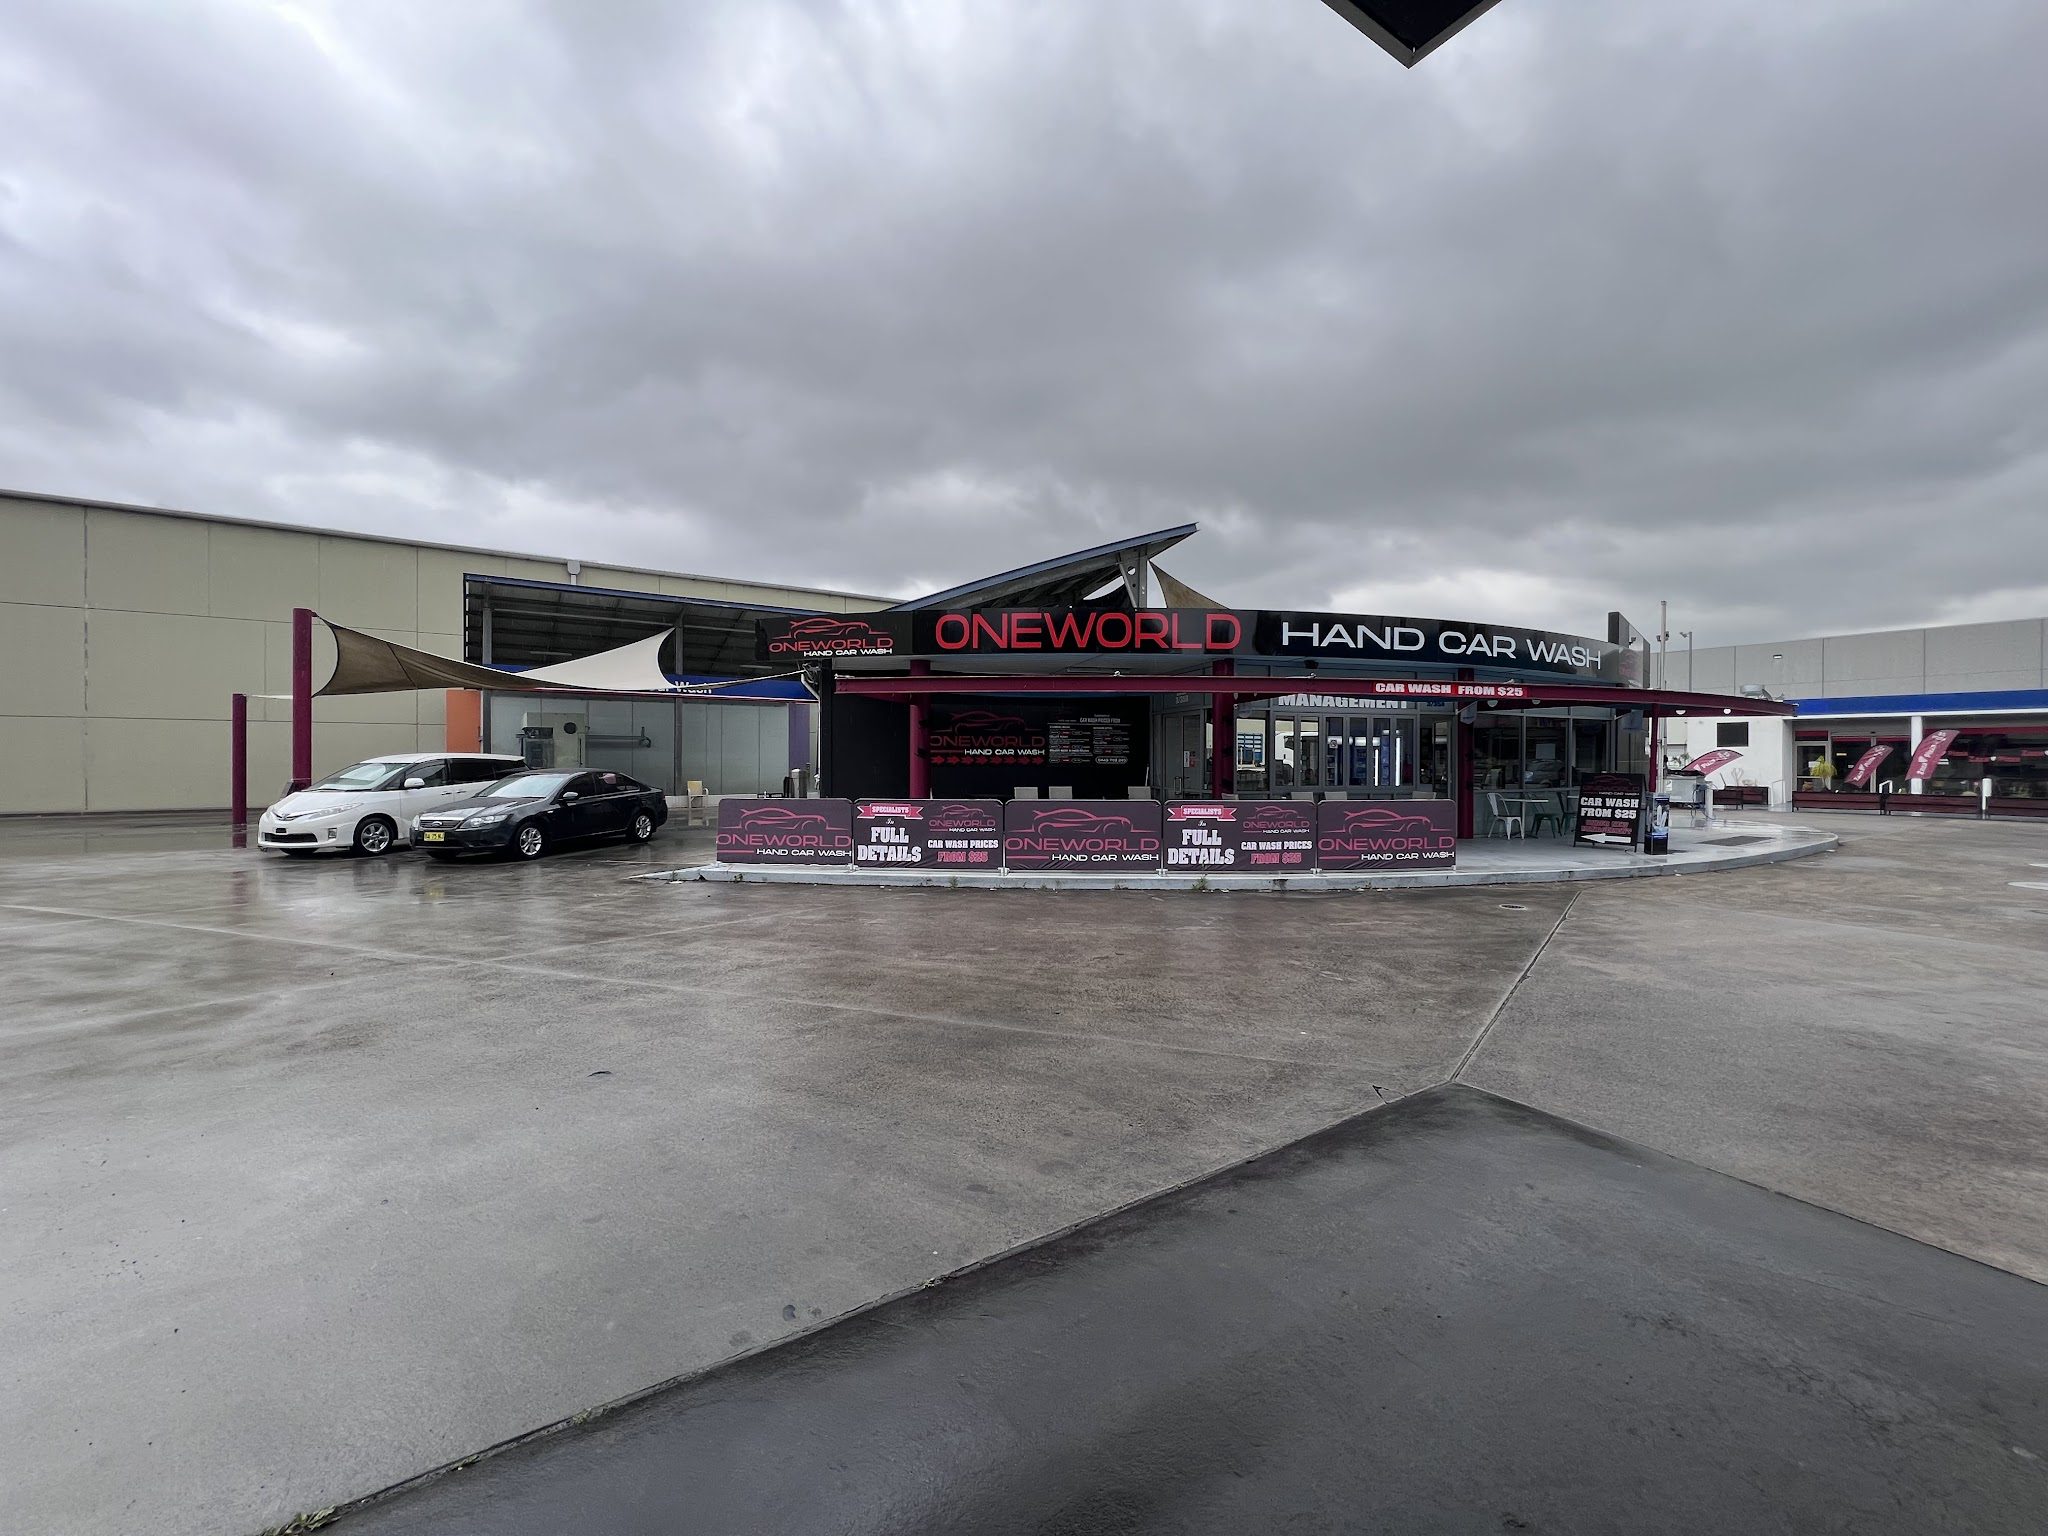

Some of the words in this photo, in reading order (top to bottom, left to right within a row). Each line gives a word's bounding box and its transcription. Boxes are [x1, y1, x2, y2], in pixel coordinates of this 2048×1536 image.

[769, 638, 894, 653] ONEWORLD
[935, 612, 1242, 650] ONEWORLD
[1282, 621, 1425, 651] HAND
[1438, 631, 1517, 660] CAR
[1525, 639, 1601, 670] WASH
[1375, 682, 1405, 693] CAR
[1407, 684, 1452, 694] WASH
[1457, 685, 1495, 696] FROM
[1497, 687, 1524, 697] $25
[1580, 797, 1603, 807] CAR
[1605, 798, 1640, 808] WASH
[871, 805, 910, 813] SPECIALISTS
[1183, 807, 1222, 815] SPECIALISTS
[1580, 808, 1612, 818] FROM
[1614, 808, 1637, 819] $25
[928, 819, 996, 827] ONEWORLD
[1242, 820, 1310, 829] ONEWORLD
[716, 834, 852, 847] ONEWORLD
[870, 827, 909, 843] FULL
[1182, 829, 1222, 846] FULL
[927, 839, 943, 848] CAR
[945, 840, 968, 848] WASH
[970, 840, 999, 849] PRICES
[1005, 838, 1160, 851] ONEWORLD
[1241, 841, 1257, 850] CAR
[1259, 841, 1282, 850] WASH
[1283, 841, 1312, 850] PRICES
[1318, 836, 1455, 851] ONEWORLD
[818, 849, 852, 857] WASH
[857, 845, 922, 862] DETAILS
[937, 851, 966, 862] FROM
[1167, 848, 1235, 865] DETAILS
[1250, 853, 1279, 864] FROM
[1396, 852, 1419, 860] CAR
[1422, 851, 1455, 859] WASH
